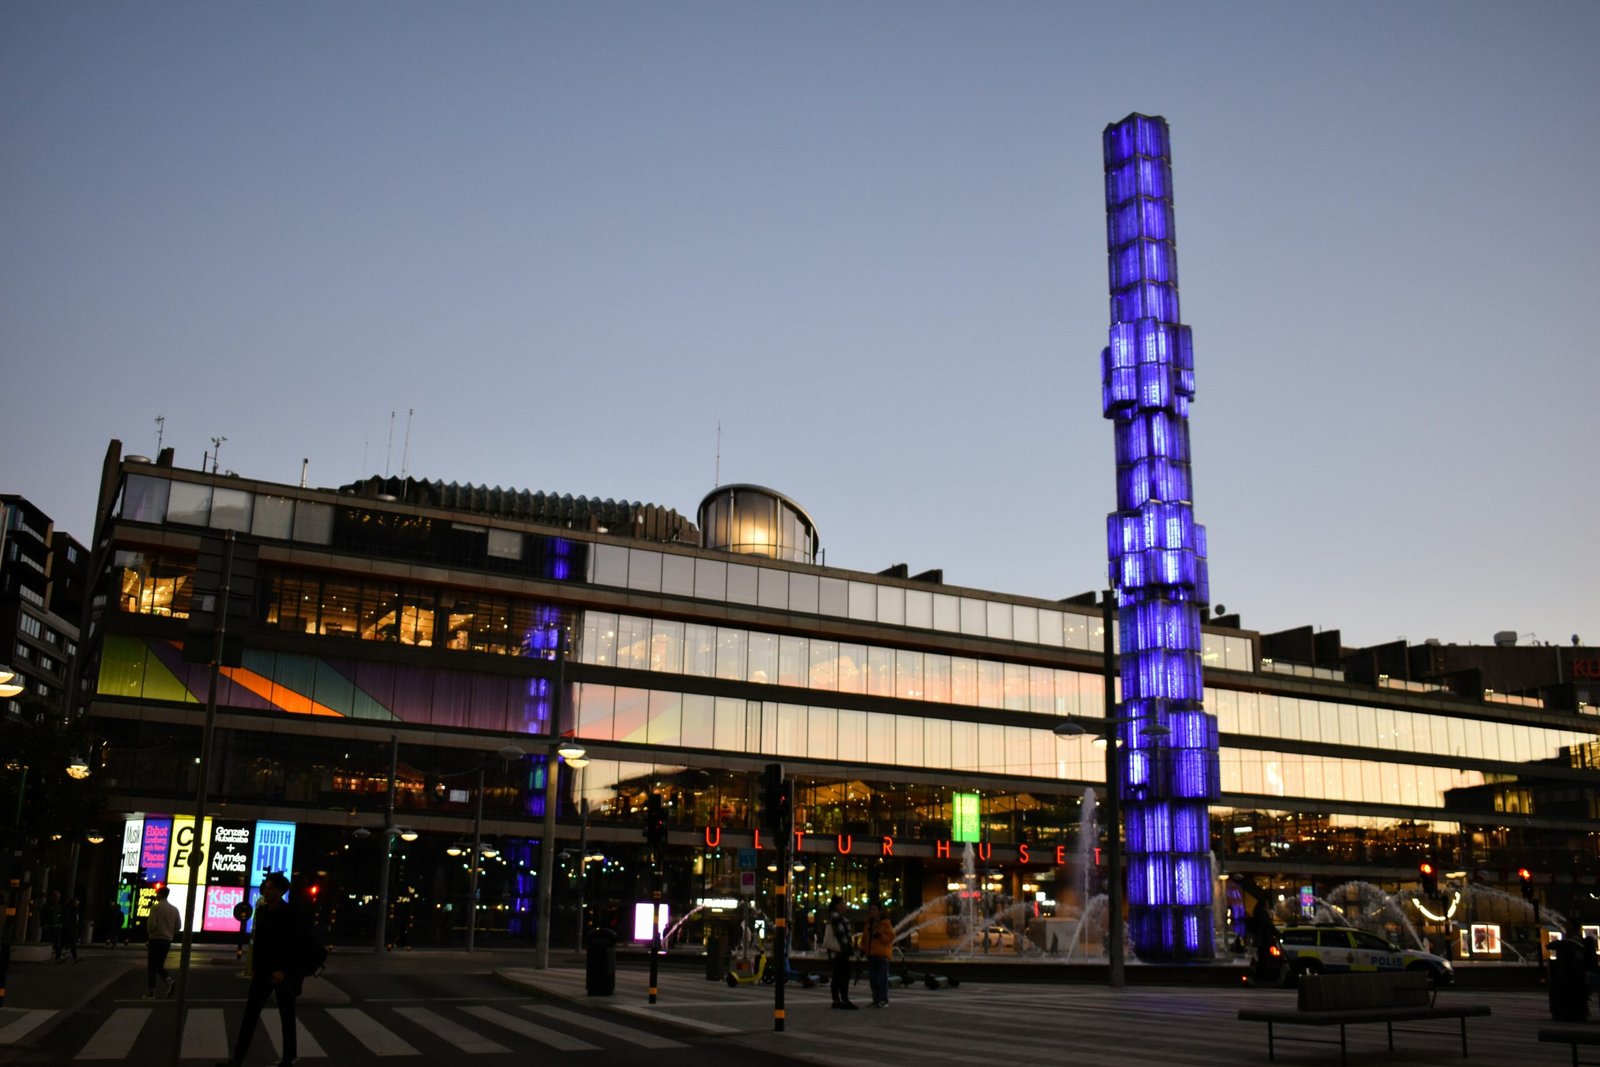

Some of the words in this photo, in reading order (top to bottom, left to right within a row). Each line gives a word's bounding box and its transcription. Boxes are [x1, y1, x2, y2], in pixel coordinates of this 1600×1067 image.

[216, 826, 249, 836] Gonzalo
[259, 829, 291, 845] JUDITH
[213, 852, 246, 863] Aymée
[256, 845, 288, 872] HILL
[212, 860, 246, 872] Nuviola
[208, 889, 244, 905] Kishi
[1371, 956, 1403, 967] POLIS
